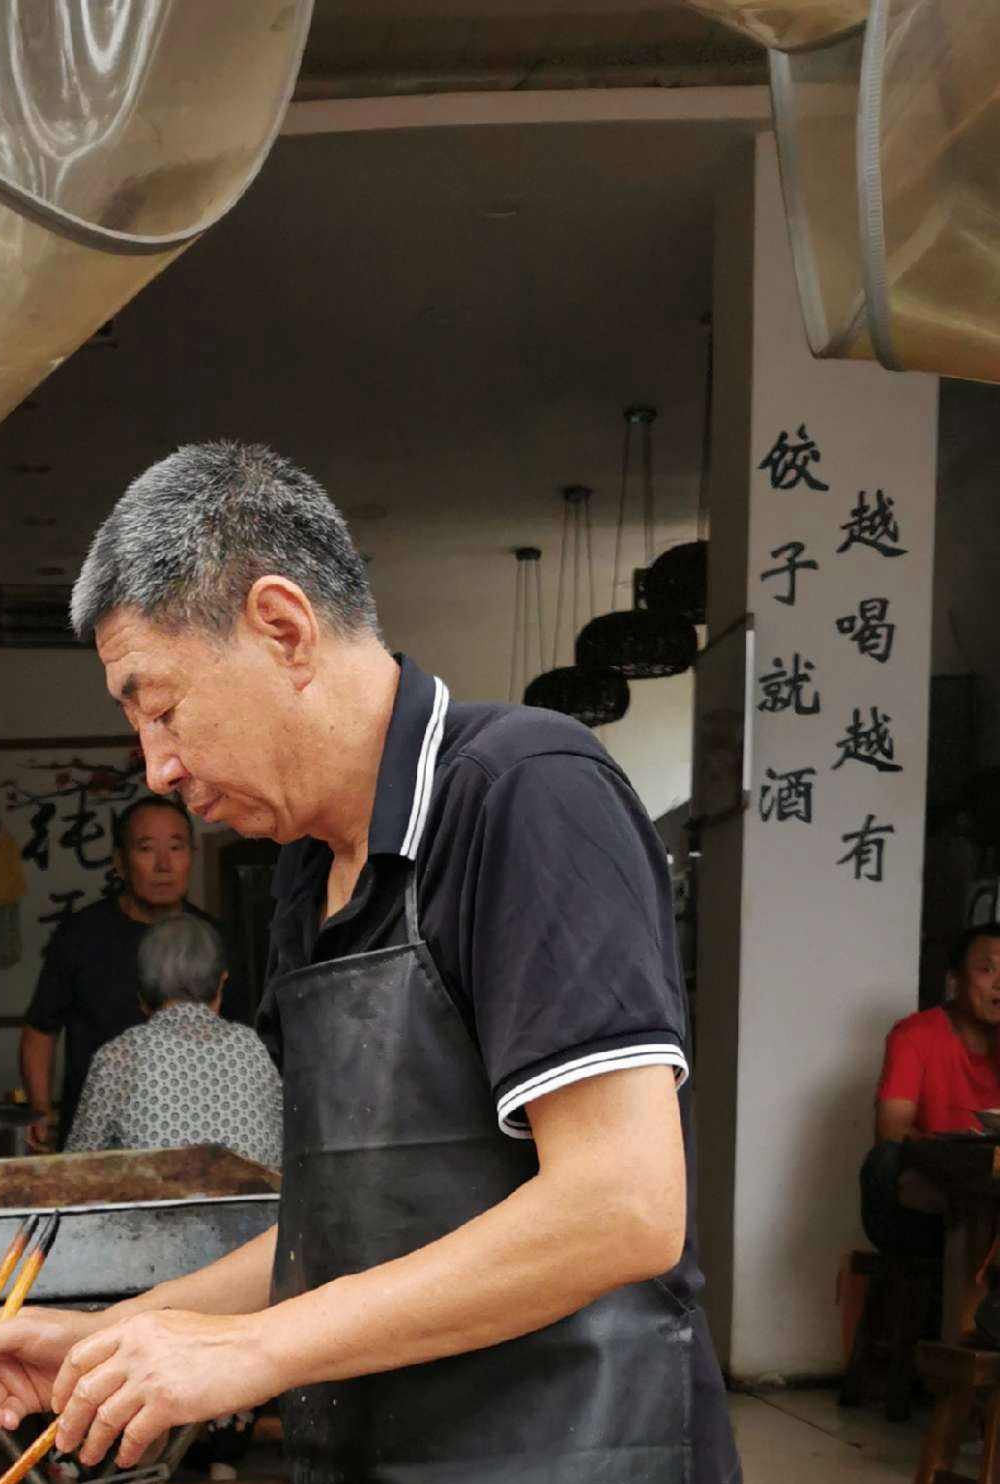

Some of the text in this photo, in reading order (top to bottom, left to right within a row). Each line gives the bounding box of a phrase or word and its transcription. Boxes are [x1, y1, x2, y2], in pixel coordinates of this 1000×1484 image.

[758, 424, 829, 824] 饺子就酒
[832, 489, 908, 882] 越喝越有
